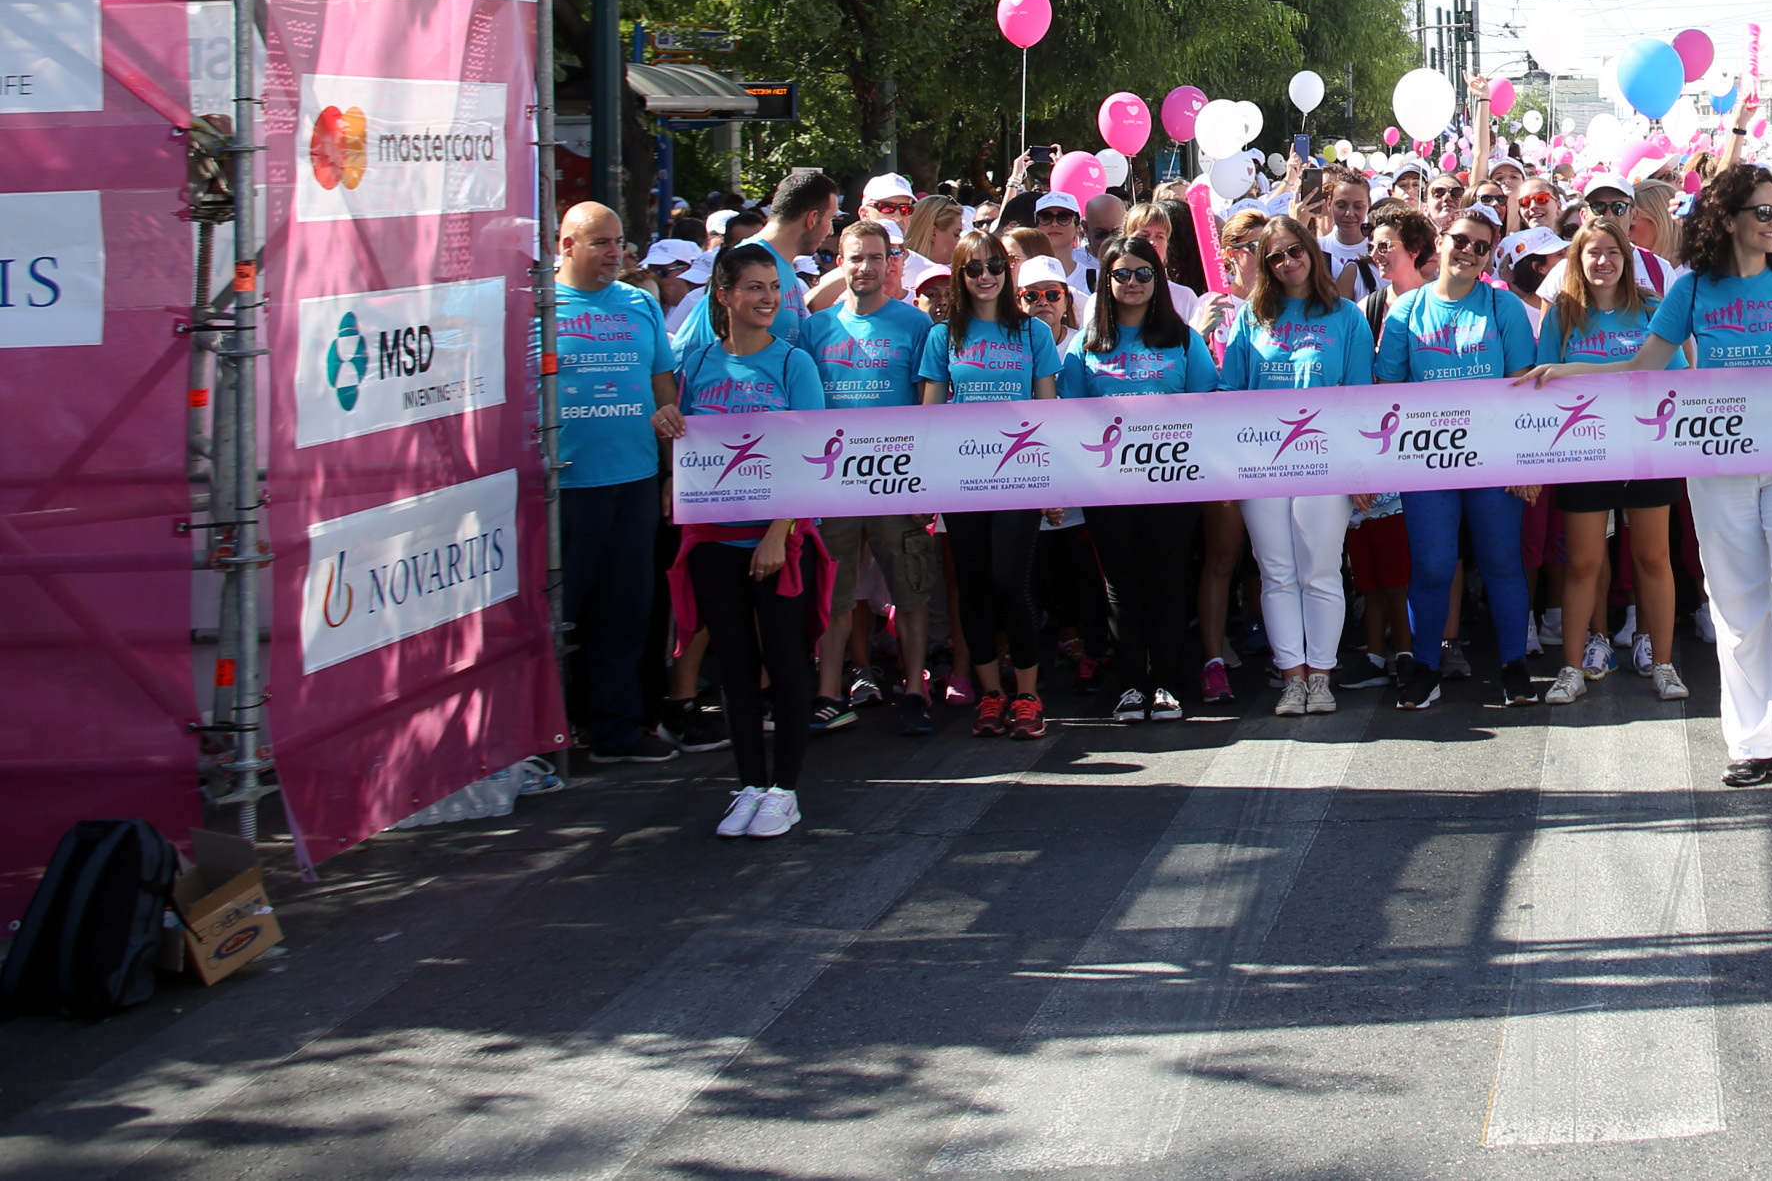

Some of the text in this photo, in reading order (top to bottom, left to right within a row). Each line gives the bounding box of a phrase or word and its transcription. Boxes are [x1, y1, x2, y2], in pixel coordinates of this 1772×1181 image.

[0, 75, 33, 96] IFE
[379, 127, 494, 162] mastercard
[1205, 206, 1225, 264] balance
[857, 339, 891, 348] RACE
[990, 342, 1023, 353] RACE
[379, 325, 434, 380] MSD
[614, 351, 638, 362] 2019
[1130, 352, 1164, 362] RACE
[1710, 347, 1724, 357] 29
[1423, 370, 1435, 380] 29
[1467, 364, 1491, 375] 2019
[866, 380, 890, 389] 2019
[999, 382, 1022, 392] 2019
[561, 404, 643, 419] ΕΘΕΛΟΝΤΗΣ
[1706, 404, 1746, 414] Greece
[1430, 417, 1470, 427] Greece
[1675, 415, 1743, 438] race
[1152, 430, 1193, 440] Greece
[1398, 428, 1467, 451] race
[874, 443, 914, 453] Greece
[1120, 441, 1189, 465] race
[842, 454, 911, 477] race
[368, 527, 505, 614] NOVARTIS
